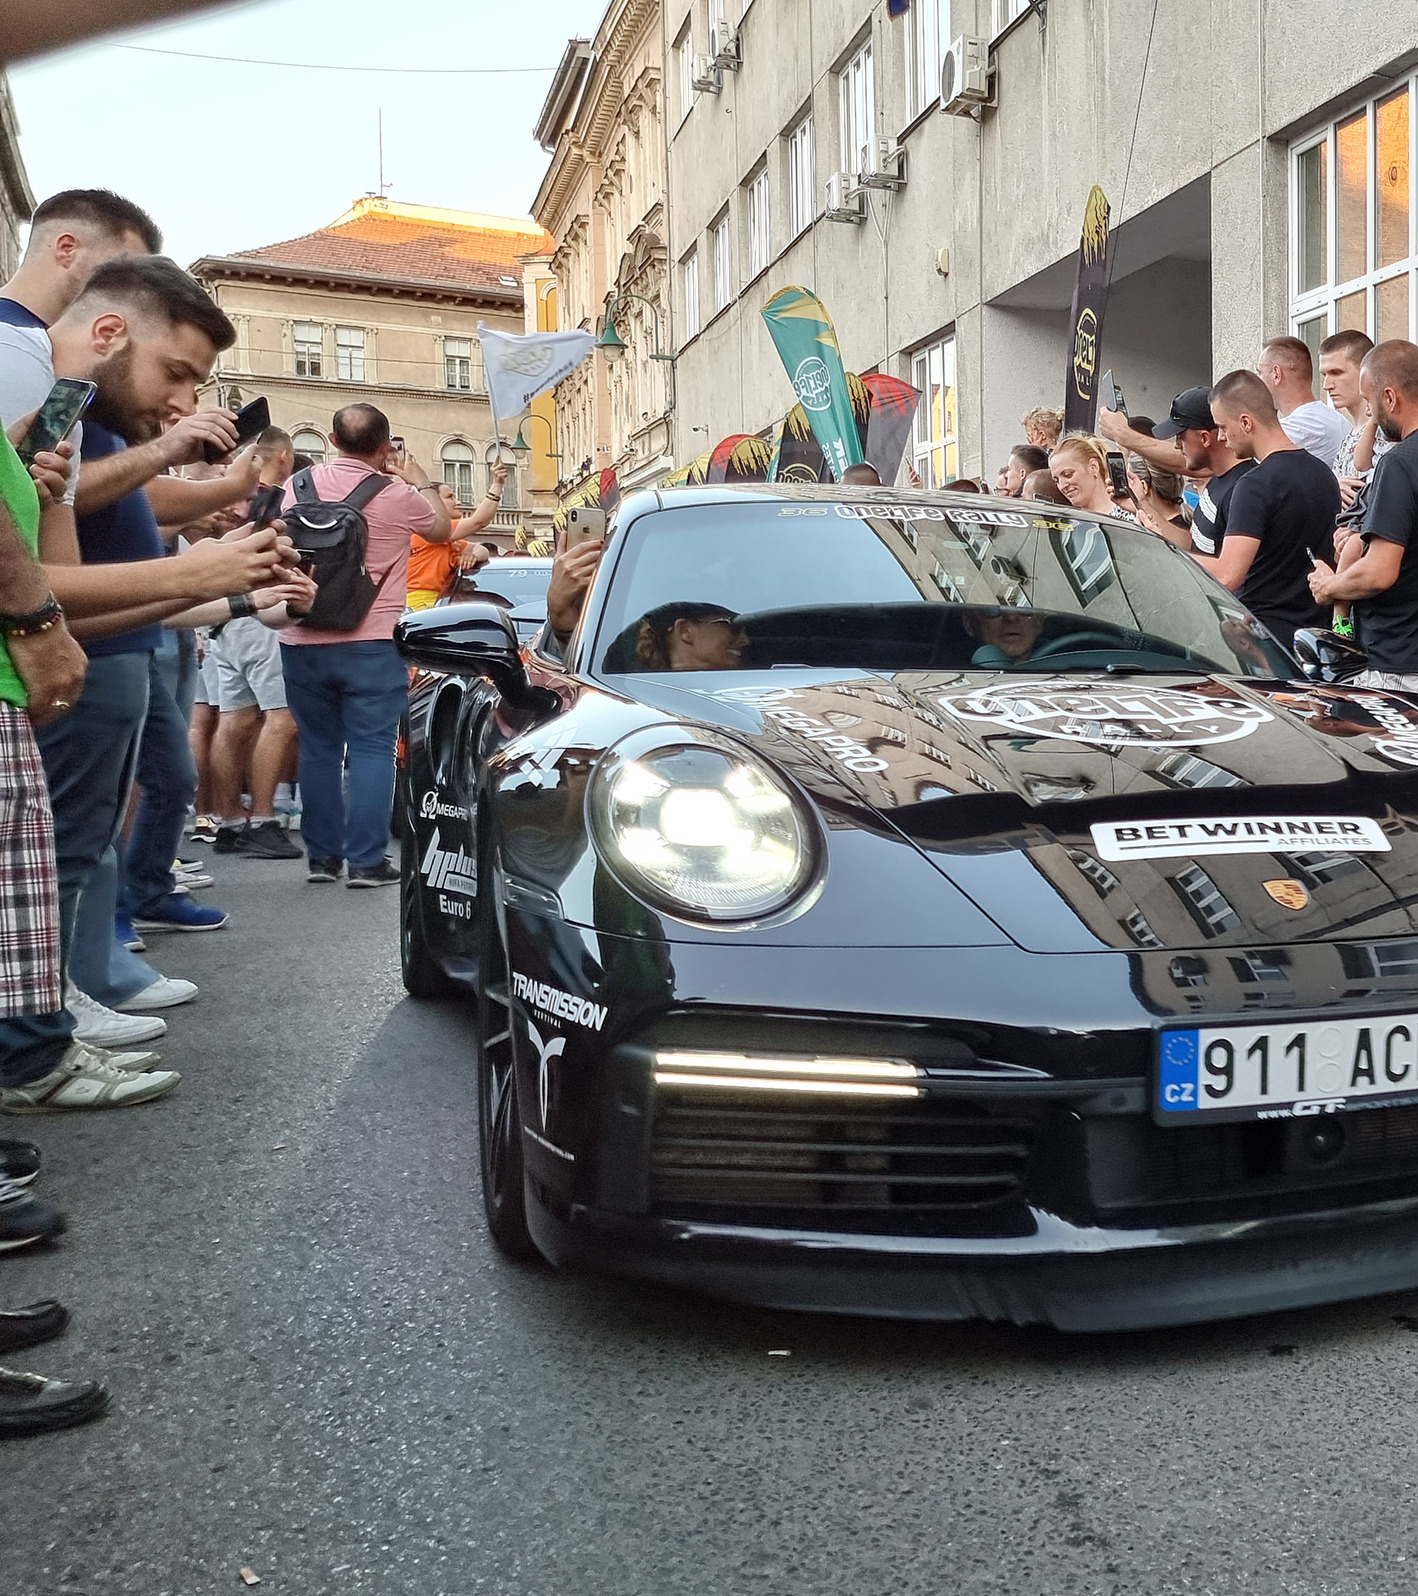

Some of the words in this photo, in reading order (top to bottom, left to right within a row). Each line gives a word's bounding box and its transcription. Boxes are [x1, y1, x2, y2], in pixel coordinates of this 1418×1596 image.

[508, 569, 528, 578] 79
[1057, 724, 1219, 734] RALLY
[1113, 821, 1364, 842] BETWINNER
[1277, 837, 1372, 846] AFFILIATES
[439, 894, 464, 917] Euro
[466, 901, 472, 919] 6
[513, 971, 608, 1031] TRANSMISSION
[1203, 1032, 1307, 1100] 911
[1165, 1083, 1194, 1102] CZ
